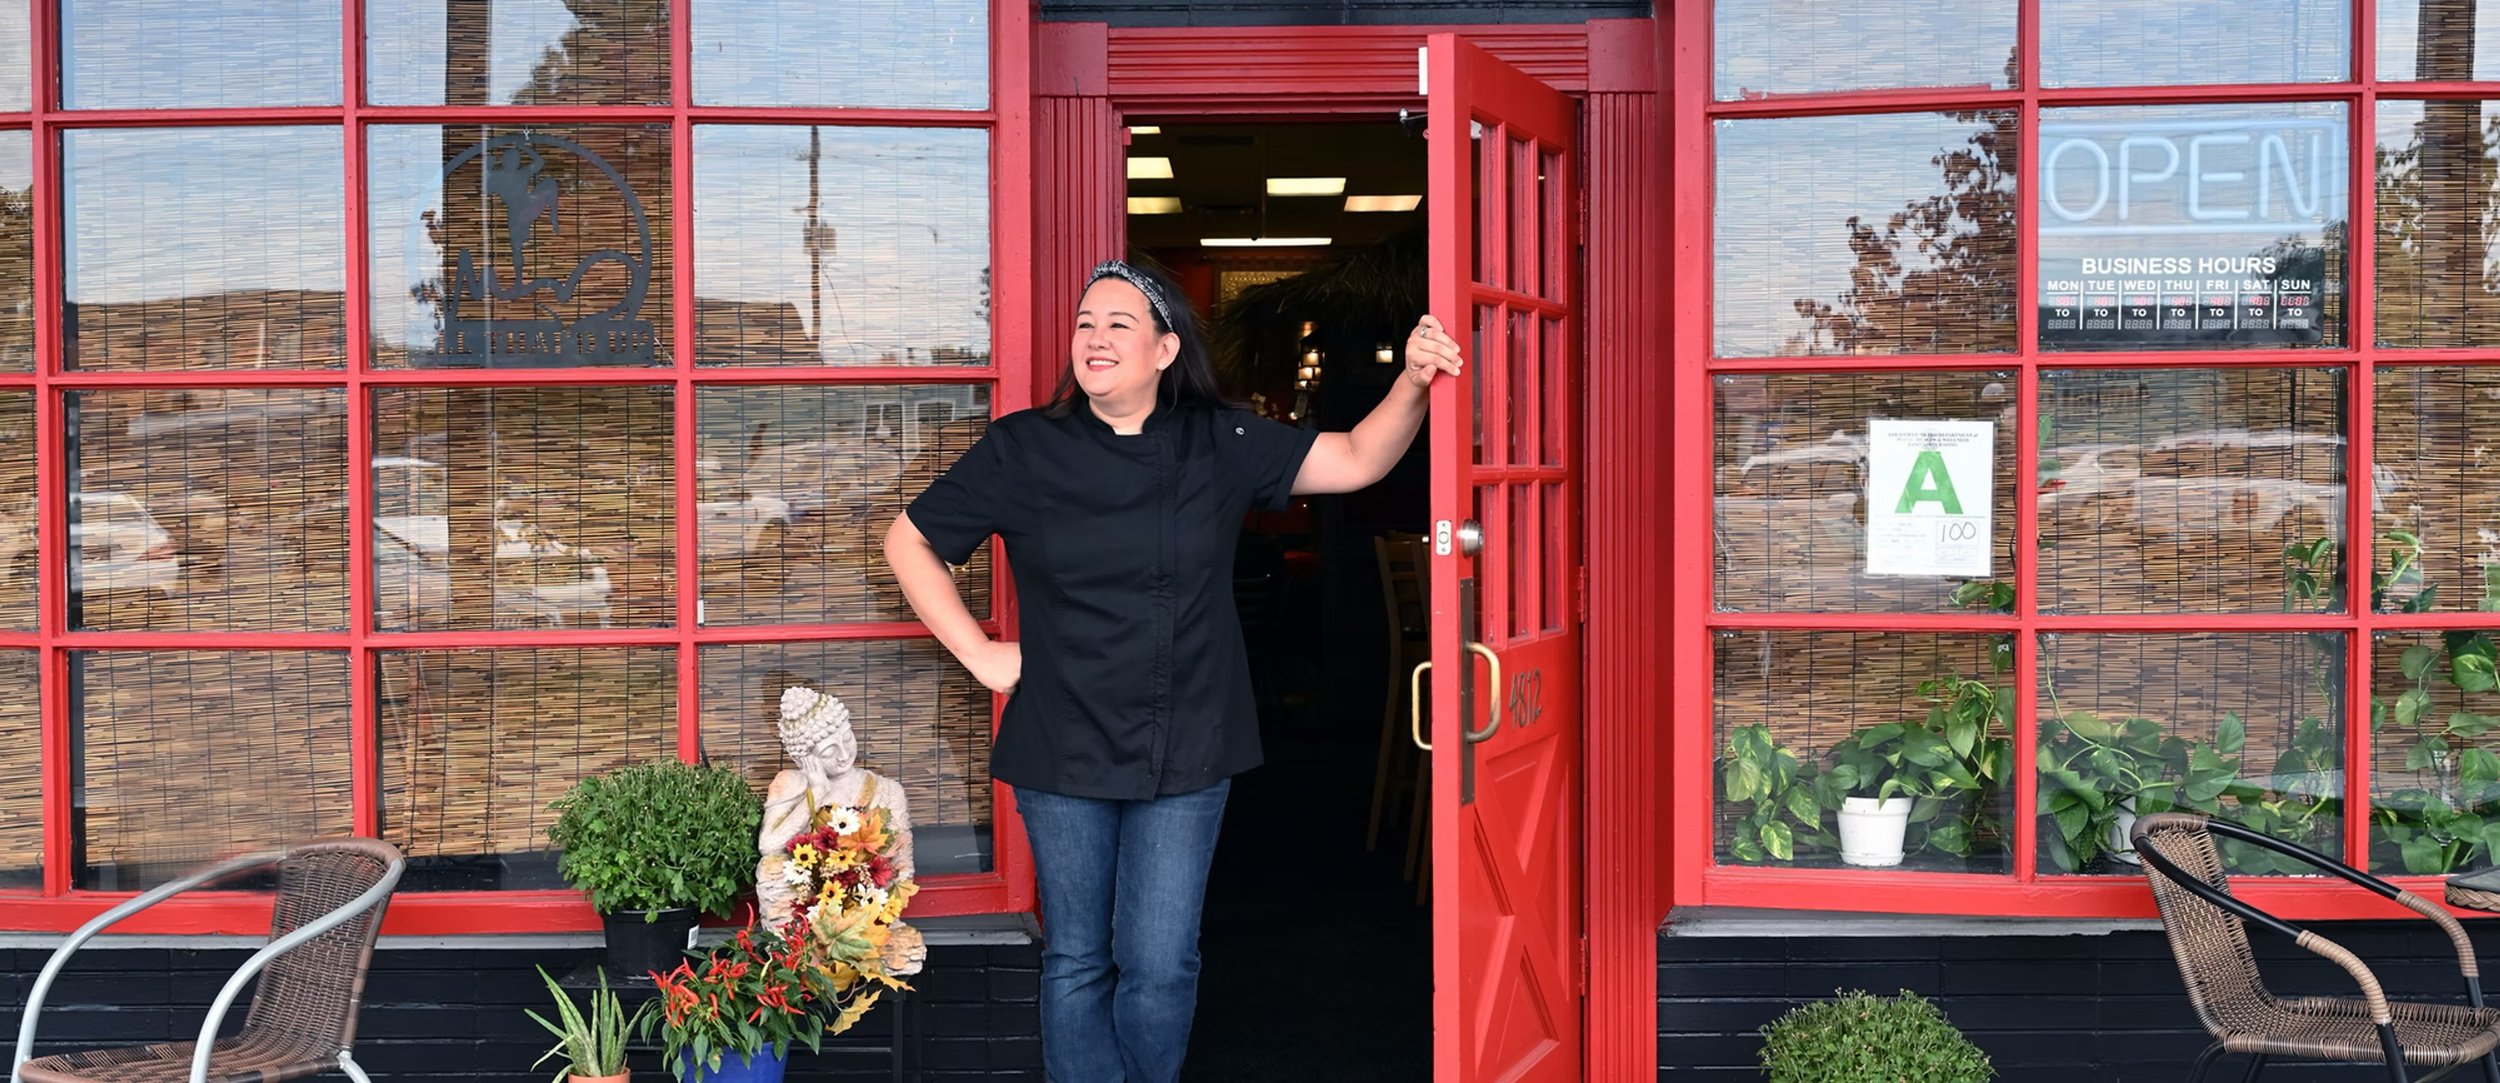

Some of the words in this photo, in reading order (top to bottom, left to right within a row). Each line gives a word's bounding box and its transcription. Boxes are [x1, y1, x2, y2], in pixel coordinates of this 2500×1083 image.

[2045, 134, 2320, 222] OPEN
[2082, 257, 2192, 275] BUSINESS
[2199, 256, 2277, 274] HOURS
[2047, 279, 2079, 291] MON
[2088, 279, 2115, 291] TUE
[2124, 279, 2156, 291] WED
[2164, 279, 2193, 291] THU
[2206, 279, 2229, 291] FRI
[2243, 279, 2270, 291] SAT
[2281, 279, 2310, 291] SUN
[2055, 308, 2070, 317] TO
[2094, 308, 2109, 317] TO
[2132, 308, 2147, 317] TO
[2170, 308, 2186, 317] TO
[2209, 308, 2225, 317] TO
[2248, 308, 2264, 317] TO
[2287, 308, 2303, 317] TO
[607, 330, 650, 353] UP
[1894, 451, 1964, 514] A
[1941, 521, 1977, 543] 100
[1508, 668, 1543, 731] 4812
